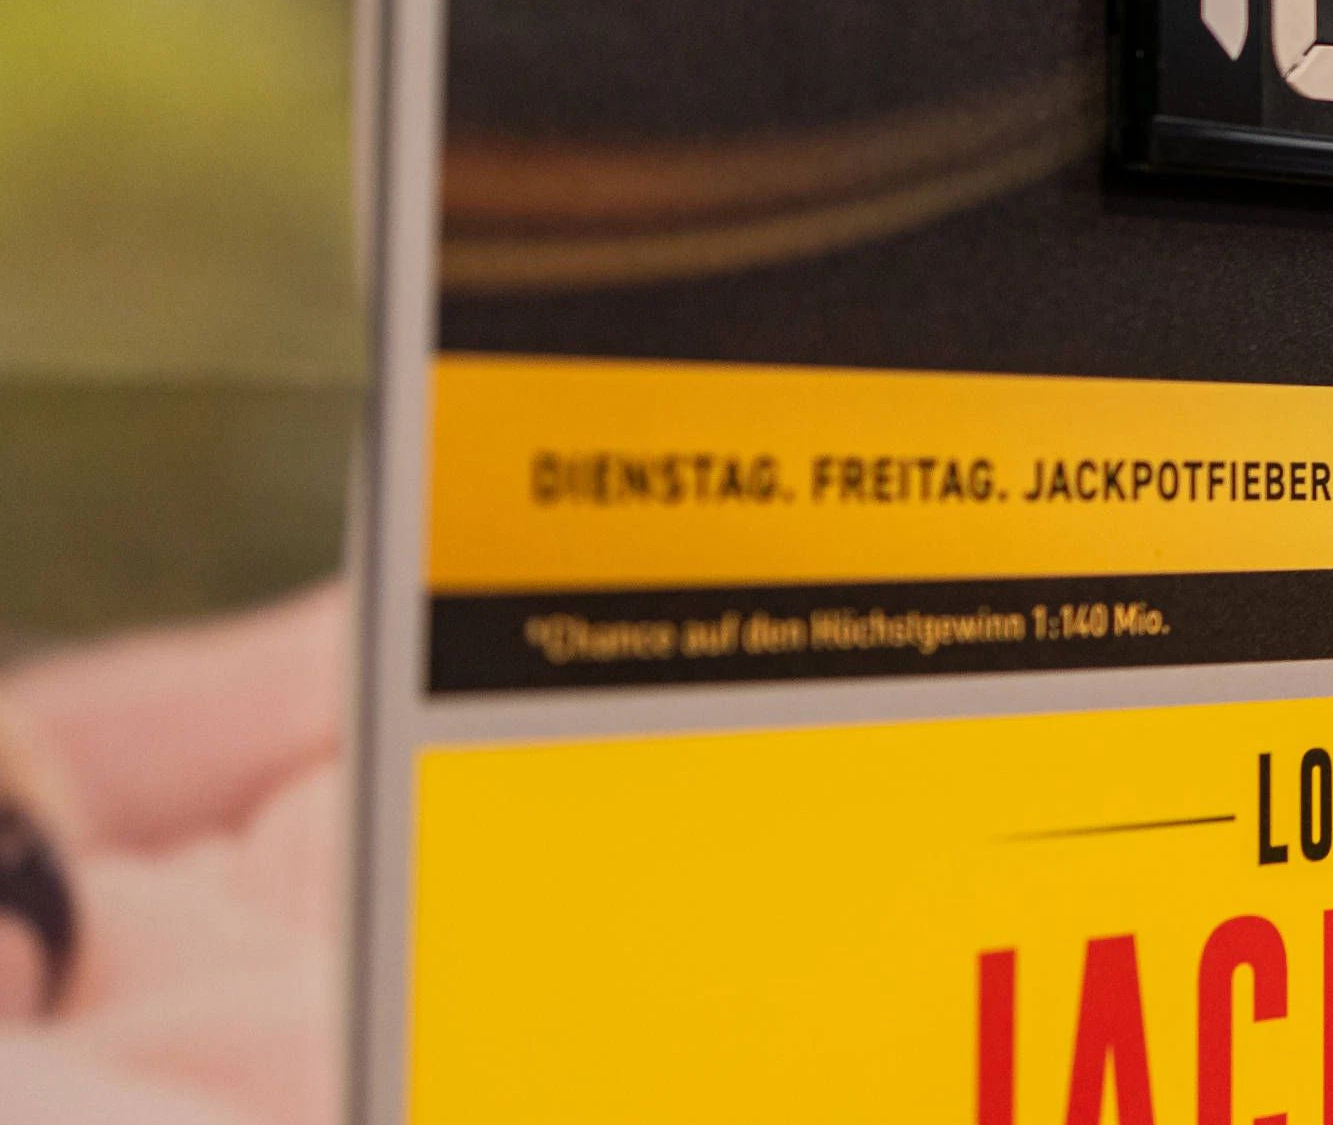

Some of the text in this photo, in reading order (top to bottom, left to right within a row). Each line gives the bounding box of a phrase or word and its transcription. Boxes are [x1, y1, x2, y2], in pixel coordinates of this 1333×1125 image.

[530, 449, 795, 507] DIENSTAG.
[811, 453, 1009, 504] FREITAG.
[1113, 601, 1171, 637] Mio.
